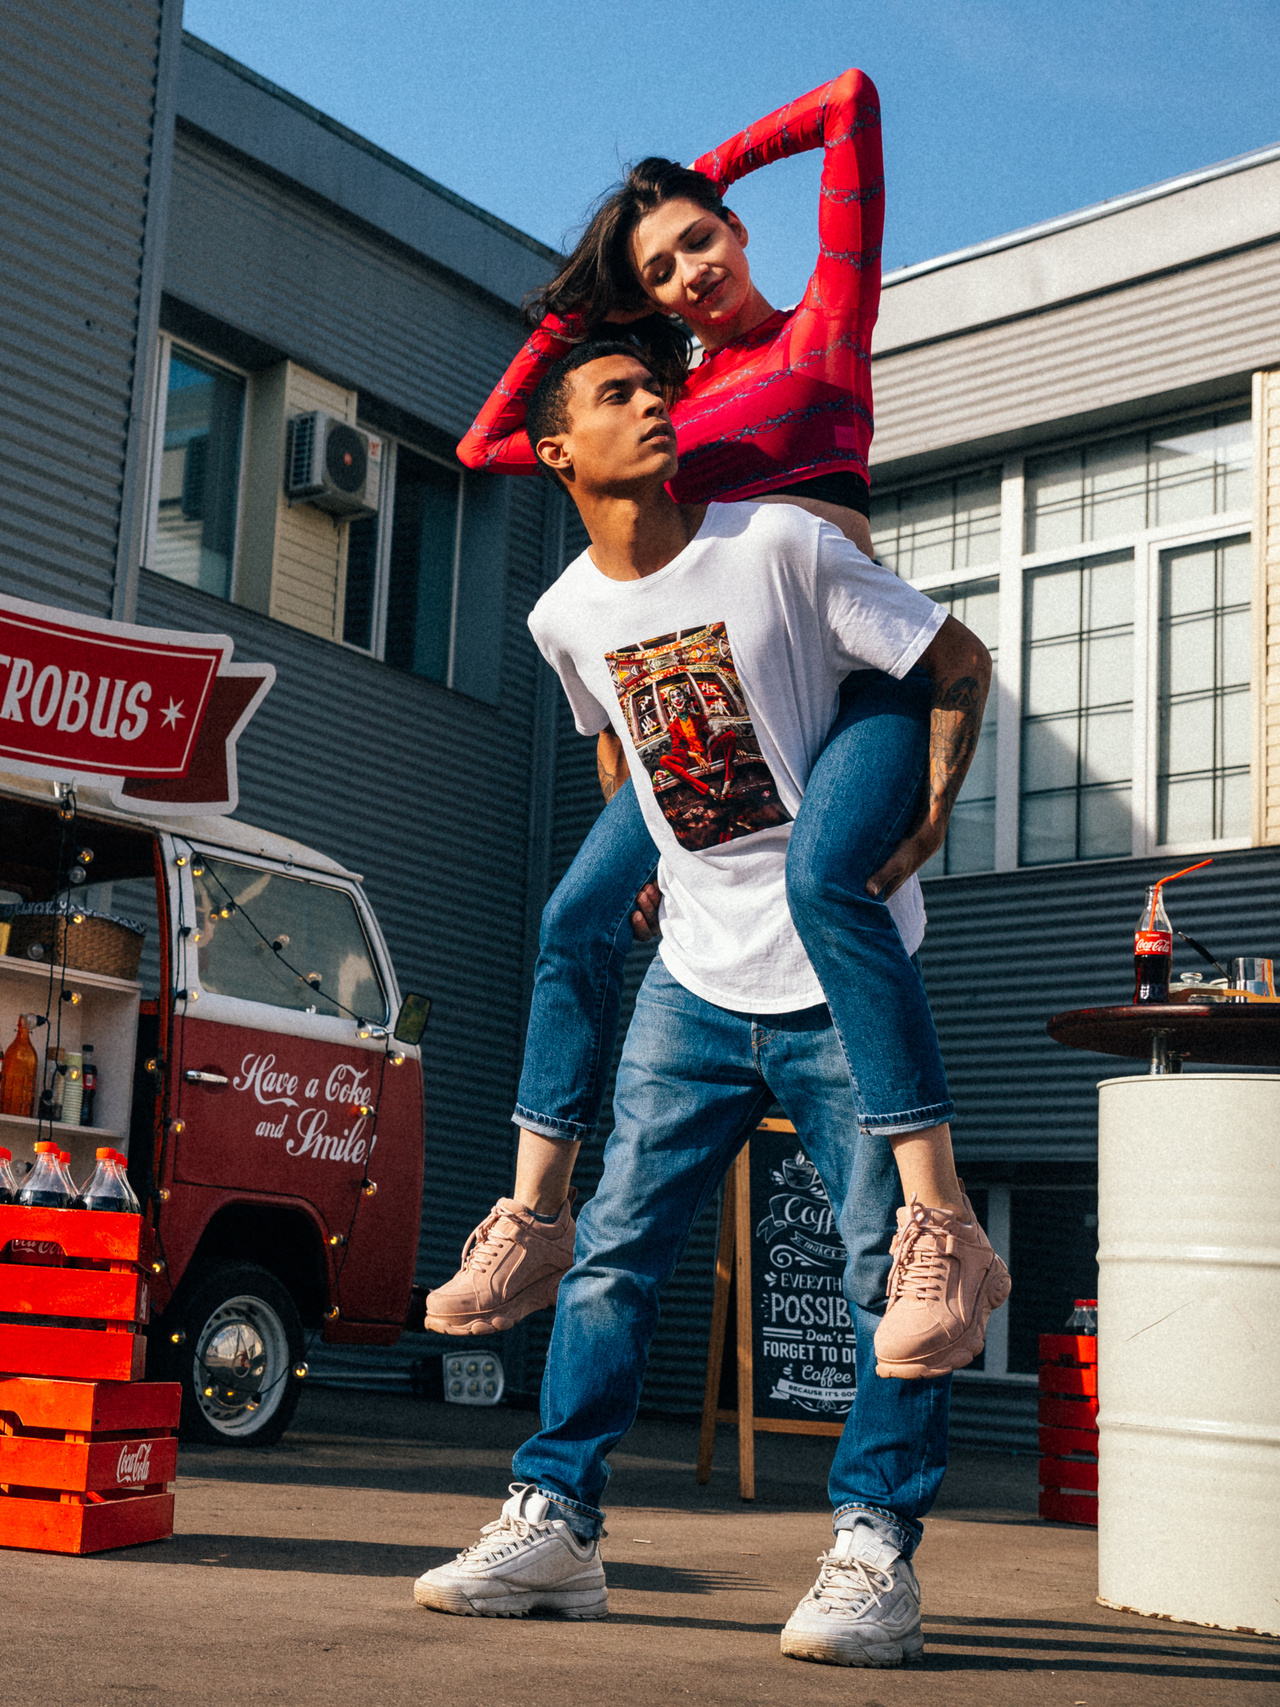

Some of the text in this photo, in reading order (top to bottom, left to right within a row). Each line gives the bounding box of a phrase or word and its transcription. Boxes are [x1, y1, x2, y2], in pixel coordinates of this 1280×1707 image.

[1136, 938, 1170, 952] Coca-Cola
[233, 1053, 371, 1107] Have a Coke
[255, 1114, 288, 1138] and
[785, 1197, 835, 1234] Coff
[804, 1241, 836, 1258] makes
[781, 1273, 842, 1291] EVERYTH
[771, 1292, 854, 1327] POSSIB
[805, 1329, 843, 1343] Don't
[763, 1341, 815, 1360] FORGET
[819, 1346, 838, 1362] TO
[802, 1364, 852, 1387] Coffee
[788, 1385, 822, 1396] BECAUSE
[116, 1443, 152, 1484] Coca-Cola
